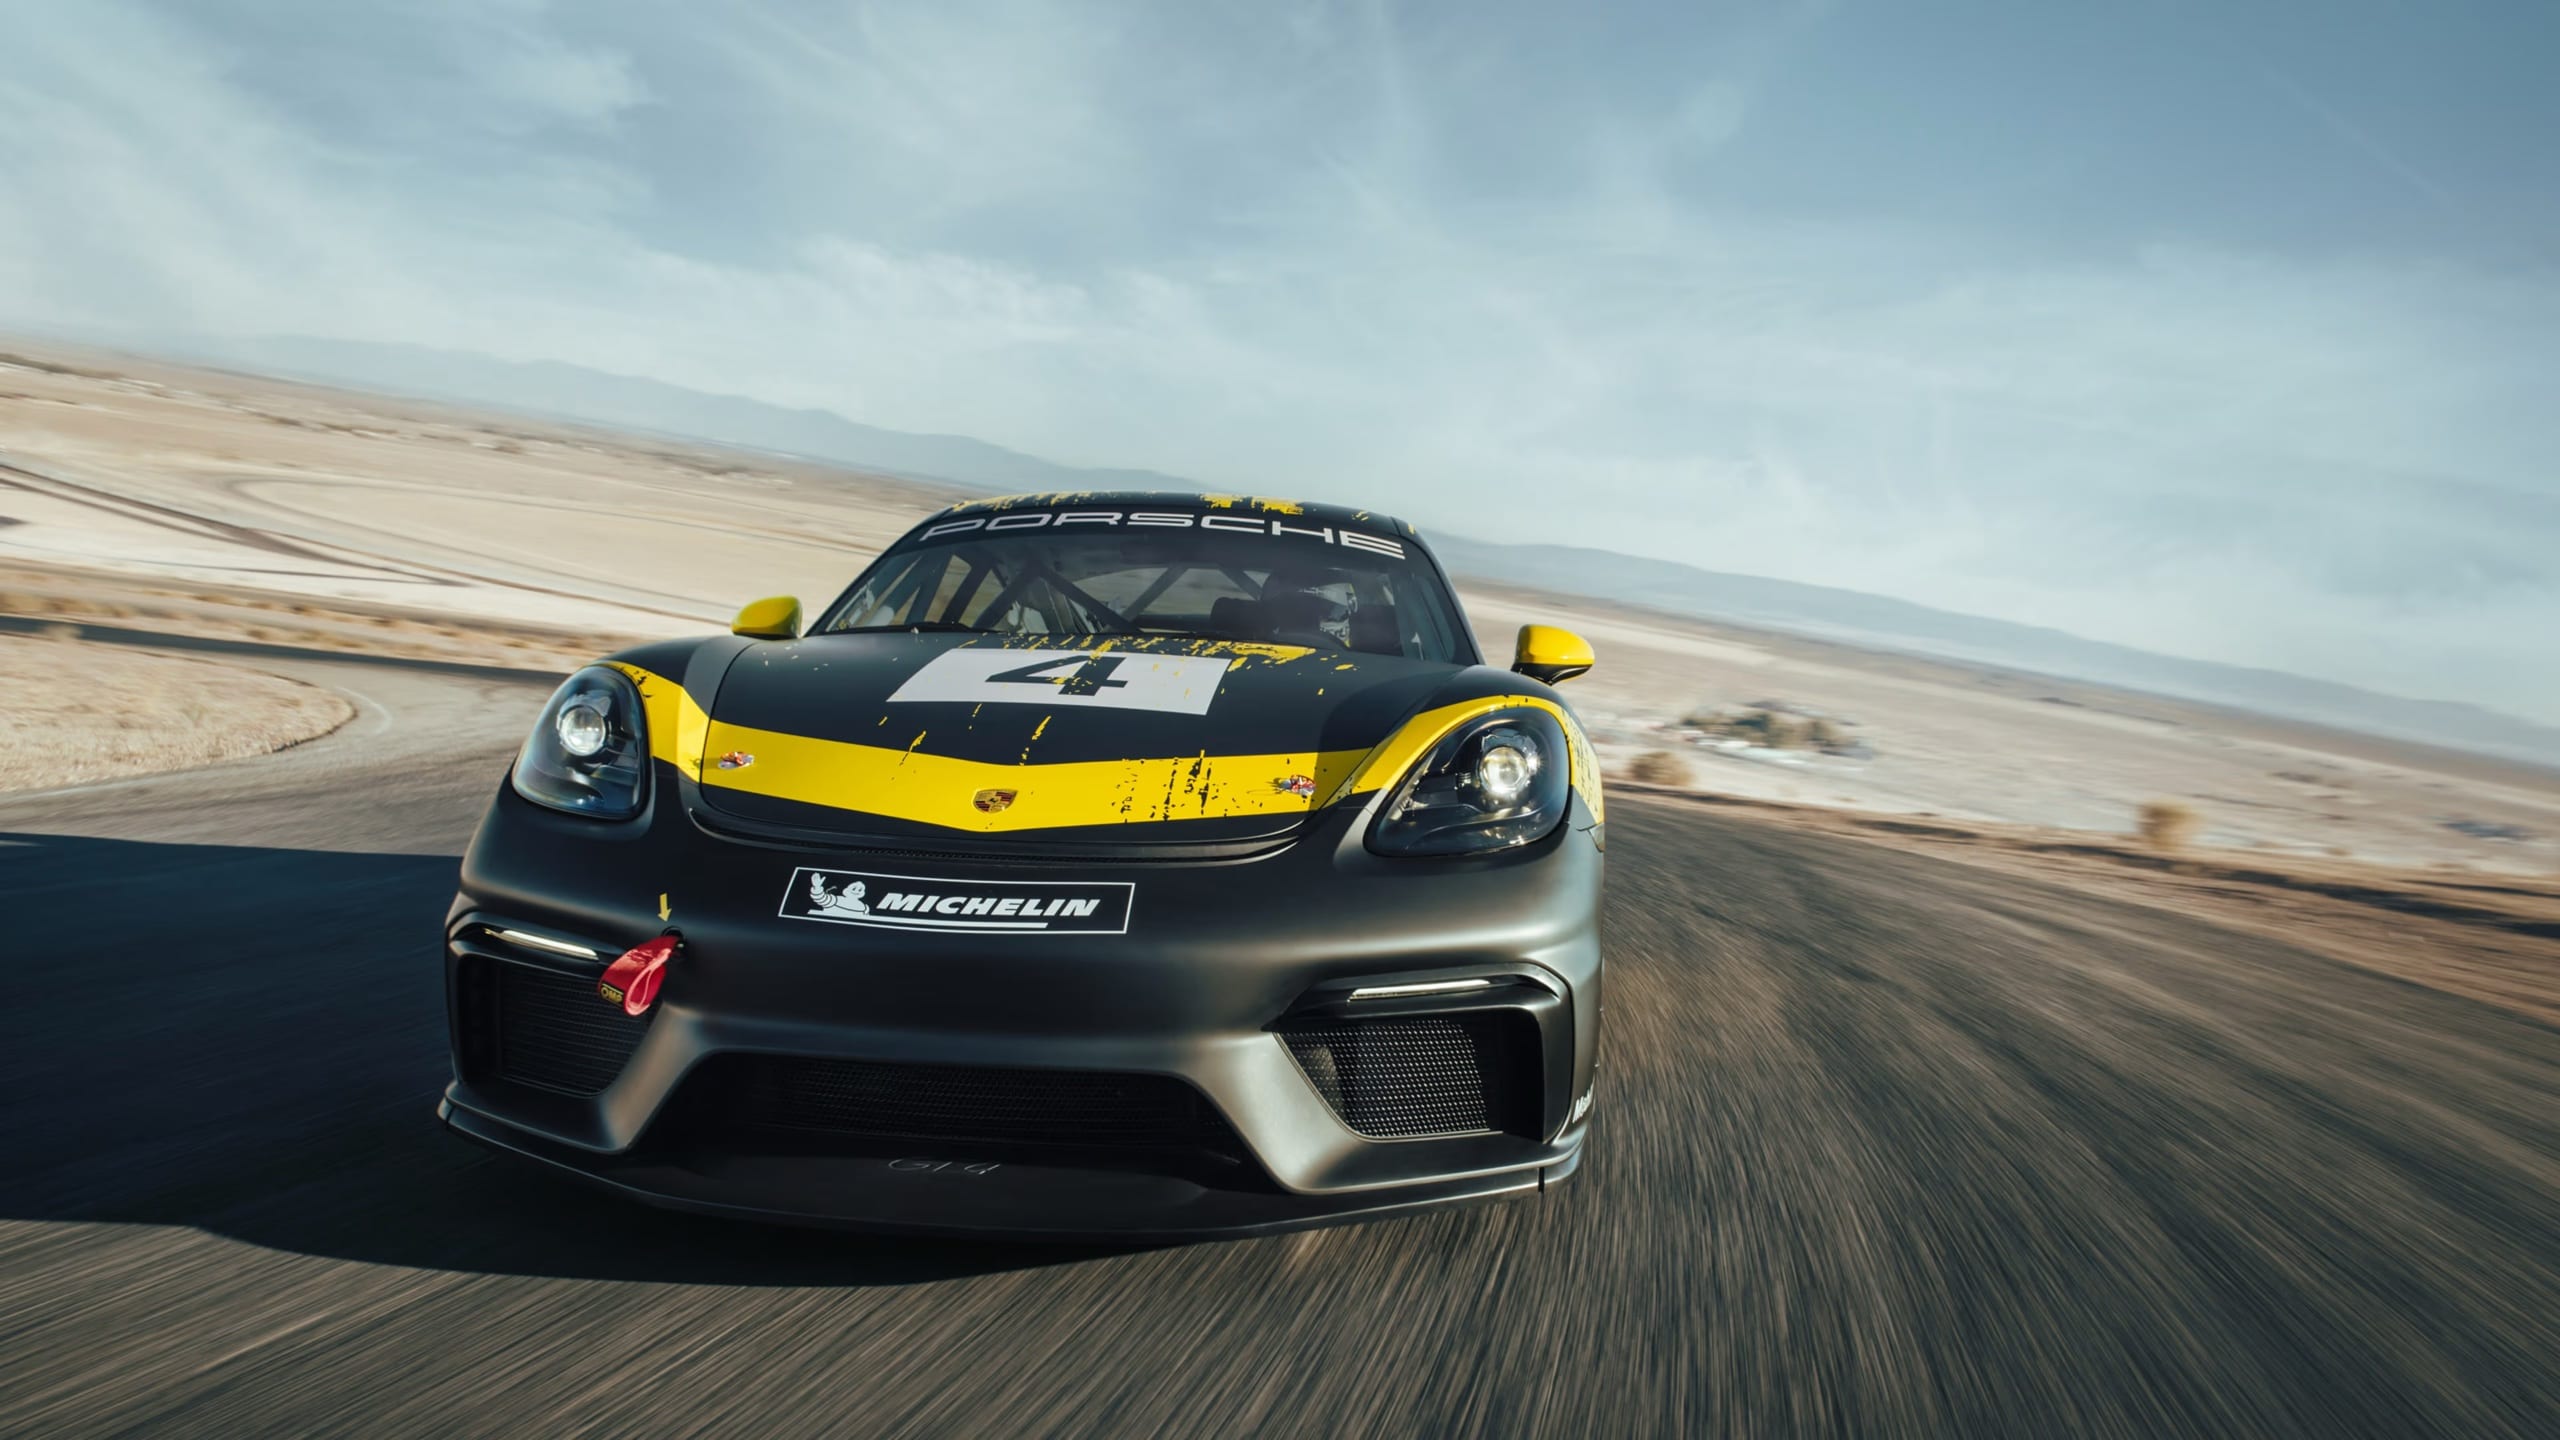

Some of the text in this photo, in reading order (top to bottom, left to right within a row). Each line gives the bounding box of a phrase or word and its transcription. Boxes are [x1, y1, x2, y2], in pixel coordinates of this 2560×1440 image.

[919, 512, 1406, 560] PORSCHE
[985, 655, 1128, 696] 4
[876, 892, 1101, 917] MICHELIN
